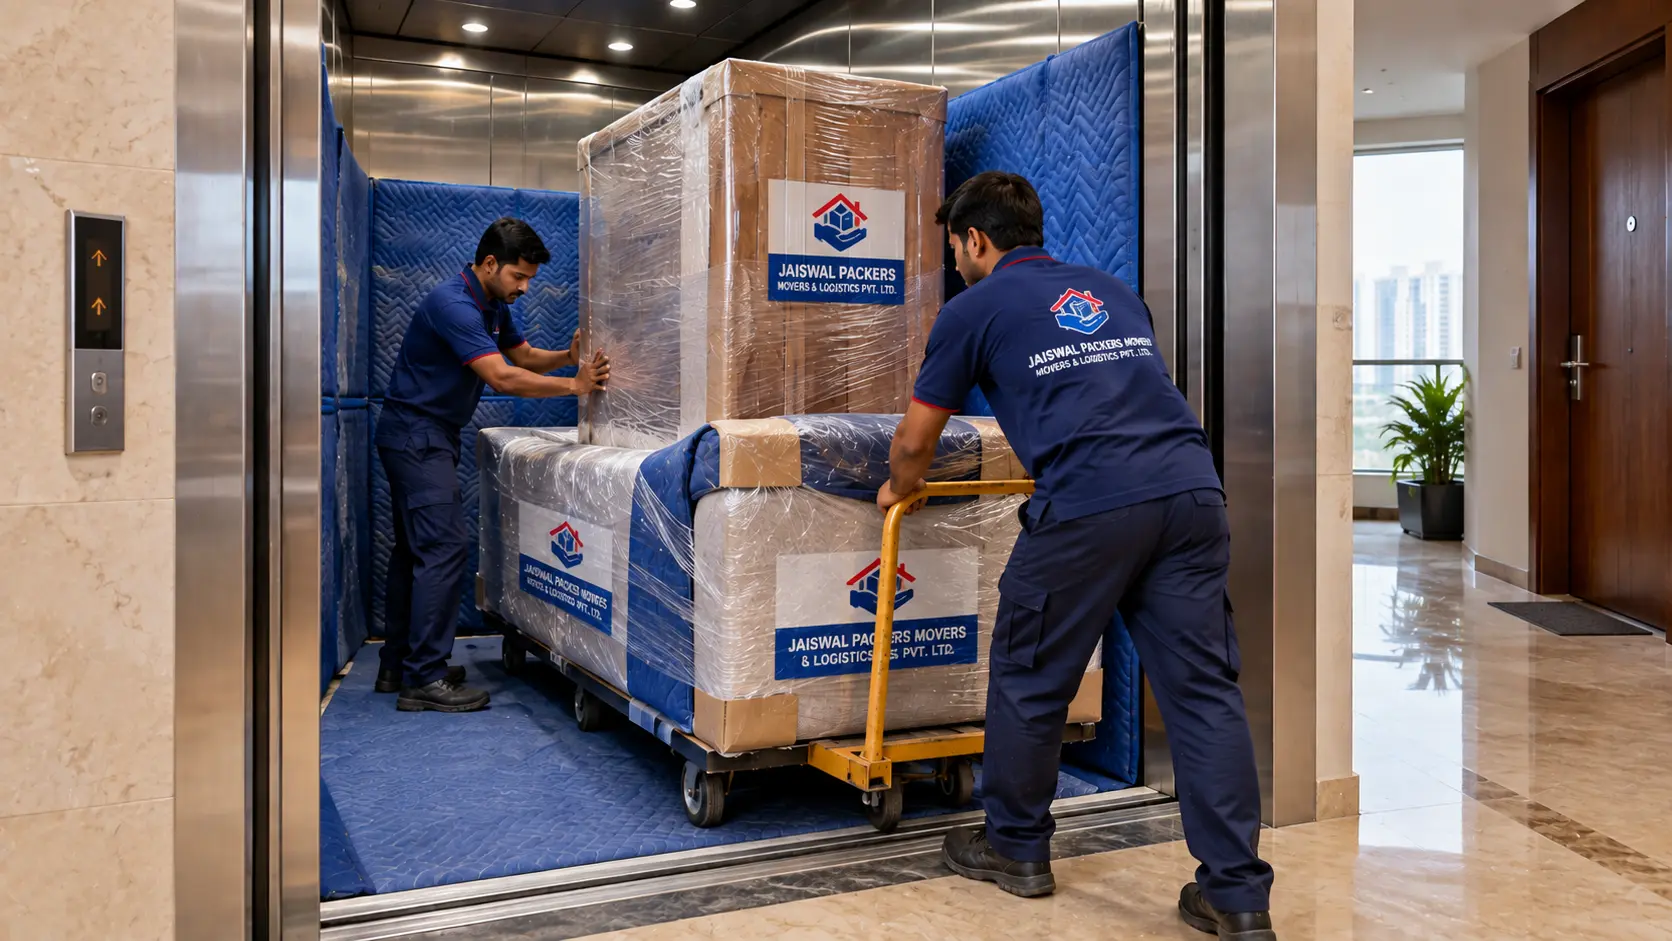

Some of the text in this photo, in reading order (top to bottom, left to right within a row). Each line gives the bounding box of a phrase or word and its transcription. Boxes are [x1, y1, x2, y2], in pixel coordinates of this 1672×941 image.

[779, 263, 896, 281] JAISWAL PACKERS
[778, 281, 897, 295] MOVERS & LOGISTICS PVT. LTD.
[1028, 344, 1080, 368] JAISWAL
[1080, 338, 1123, 353] PACKERS
[1036, 360, 1071, 377] MOVERS
[788, 626, 967, 653] JAISWAL PACERS MOVERS
[801, 655, 809, 667] &
[903, 646, 928, 660] PVT.
